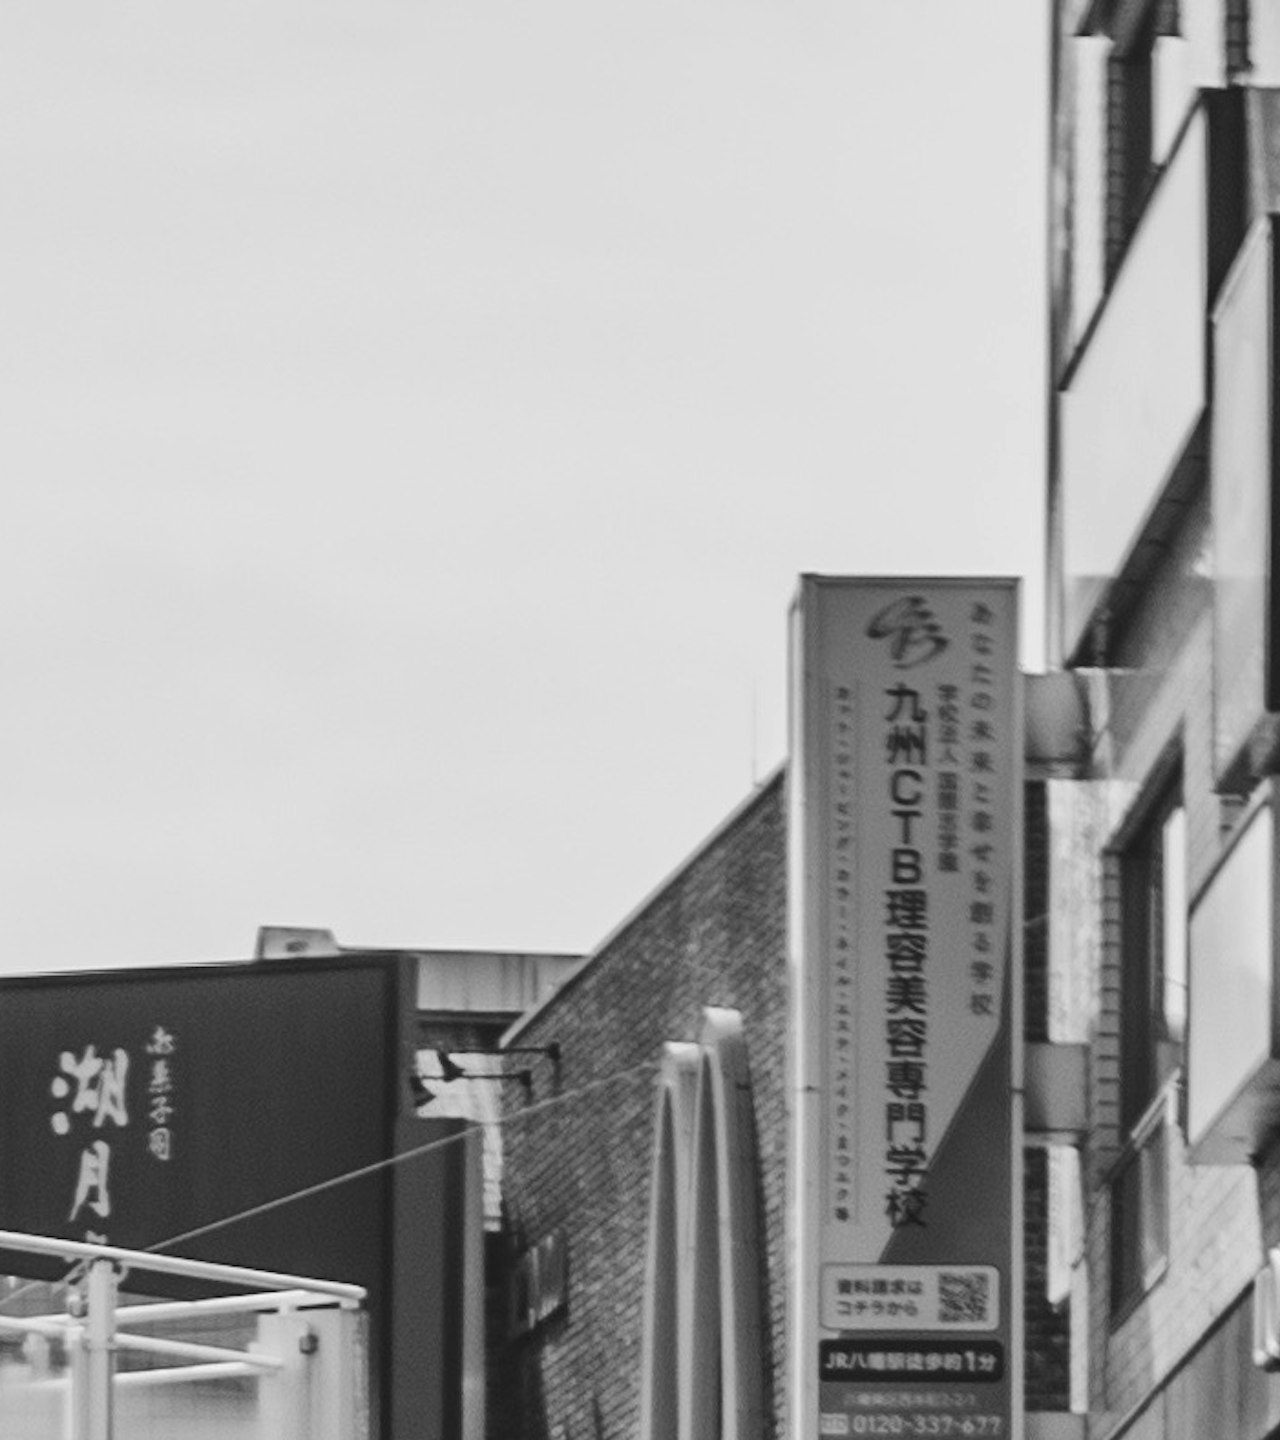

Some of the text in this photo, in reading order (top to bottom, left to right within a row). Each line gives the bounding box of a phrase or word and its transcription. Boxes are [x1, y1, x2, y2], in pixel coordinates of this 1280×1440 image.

[884, 682, 928, 1229] 九州CTB理容美容専門学校
[50, 1044, 130, 1246] 湖月
